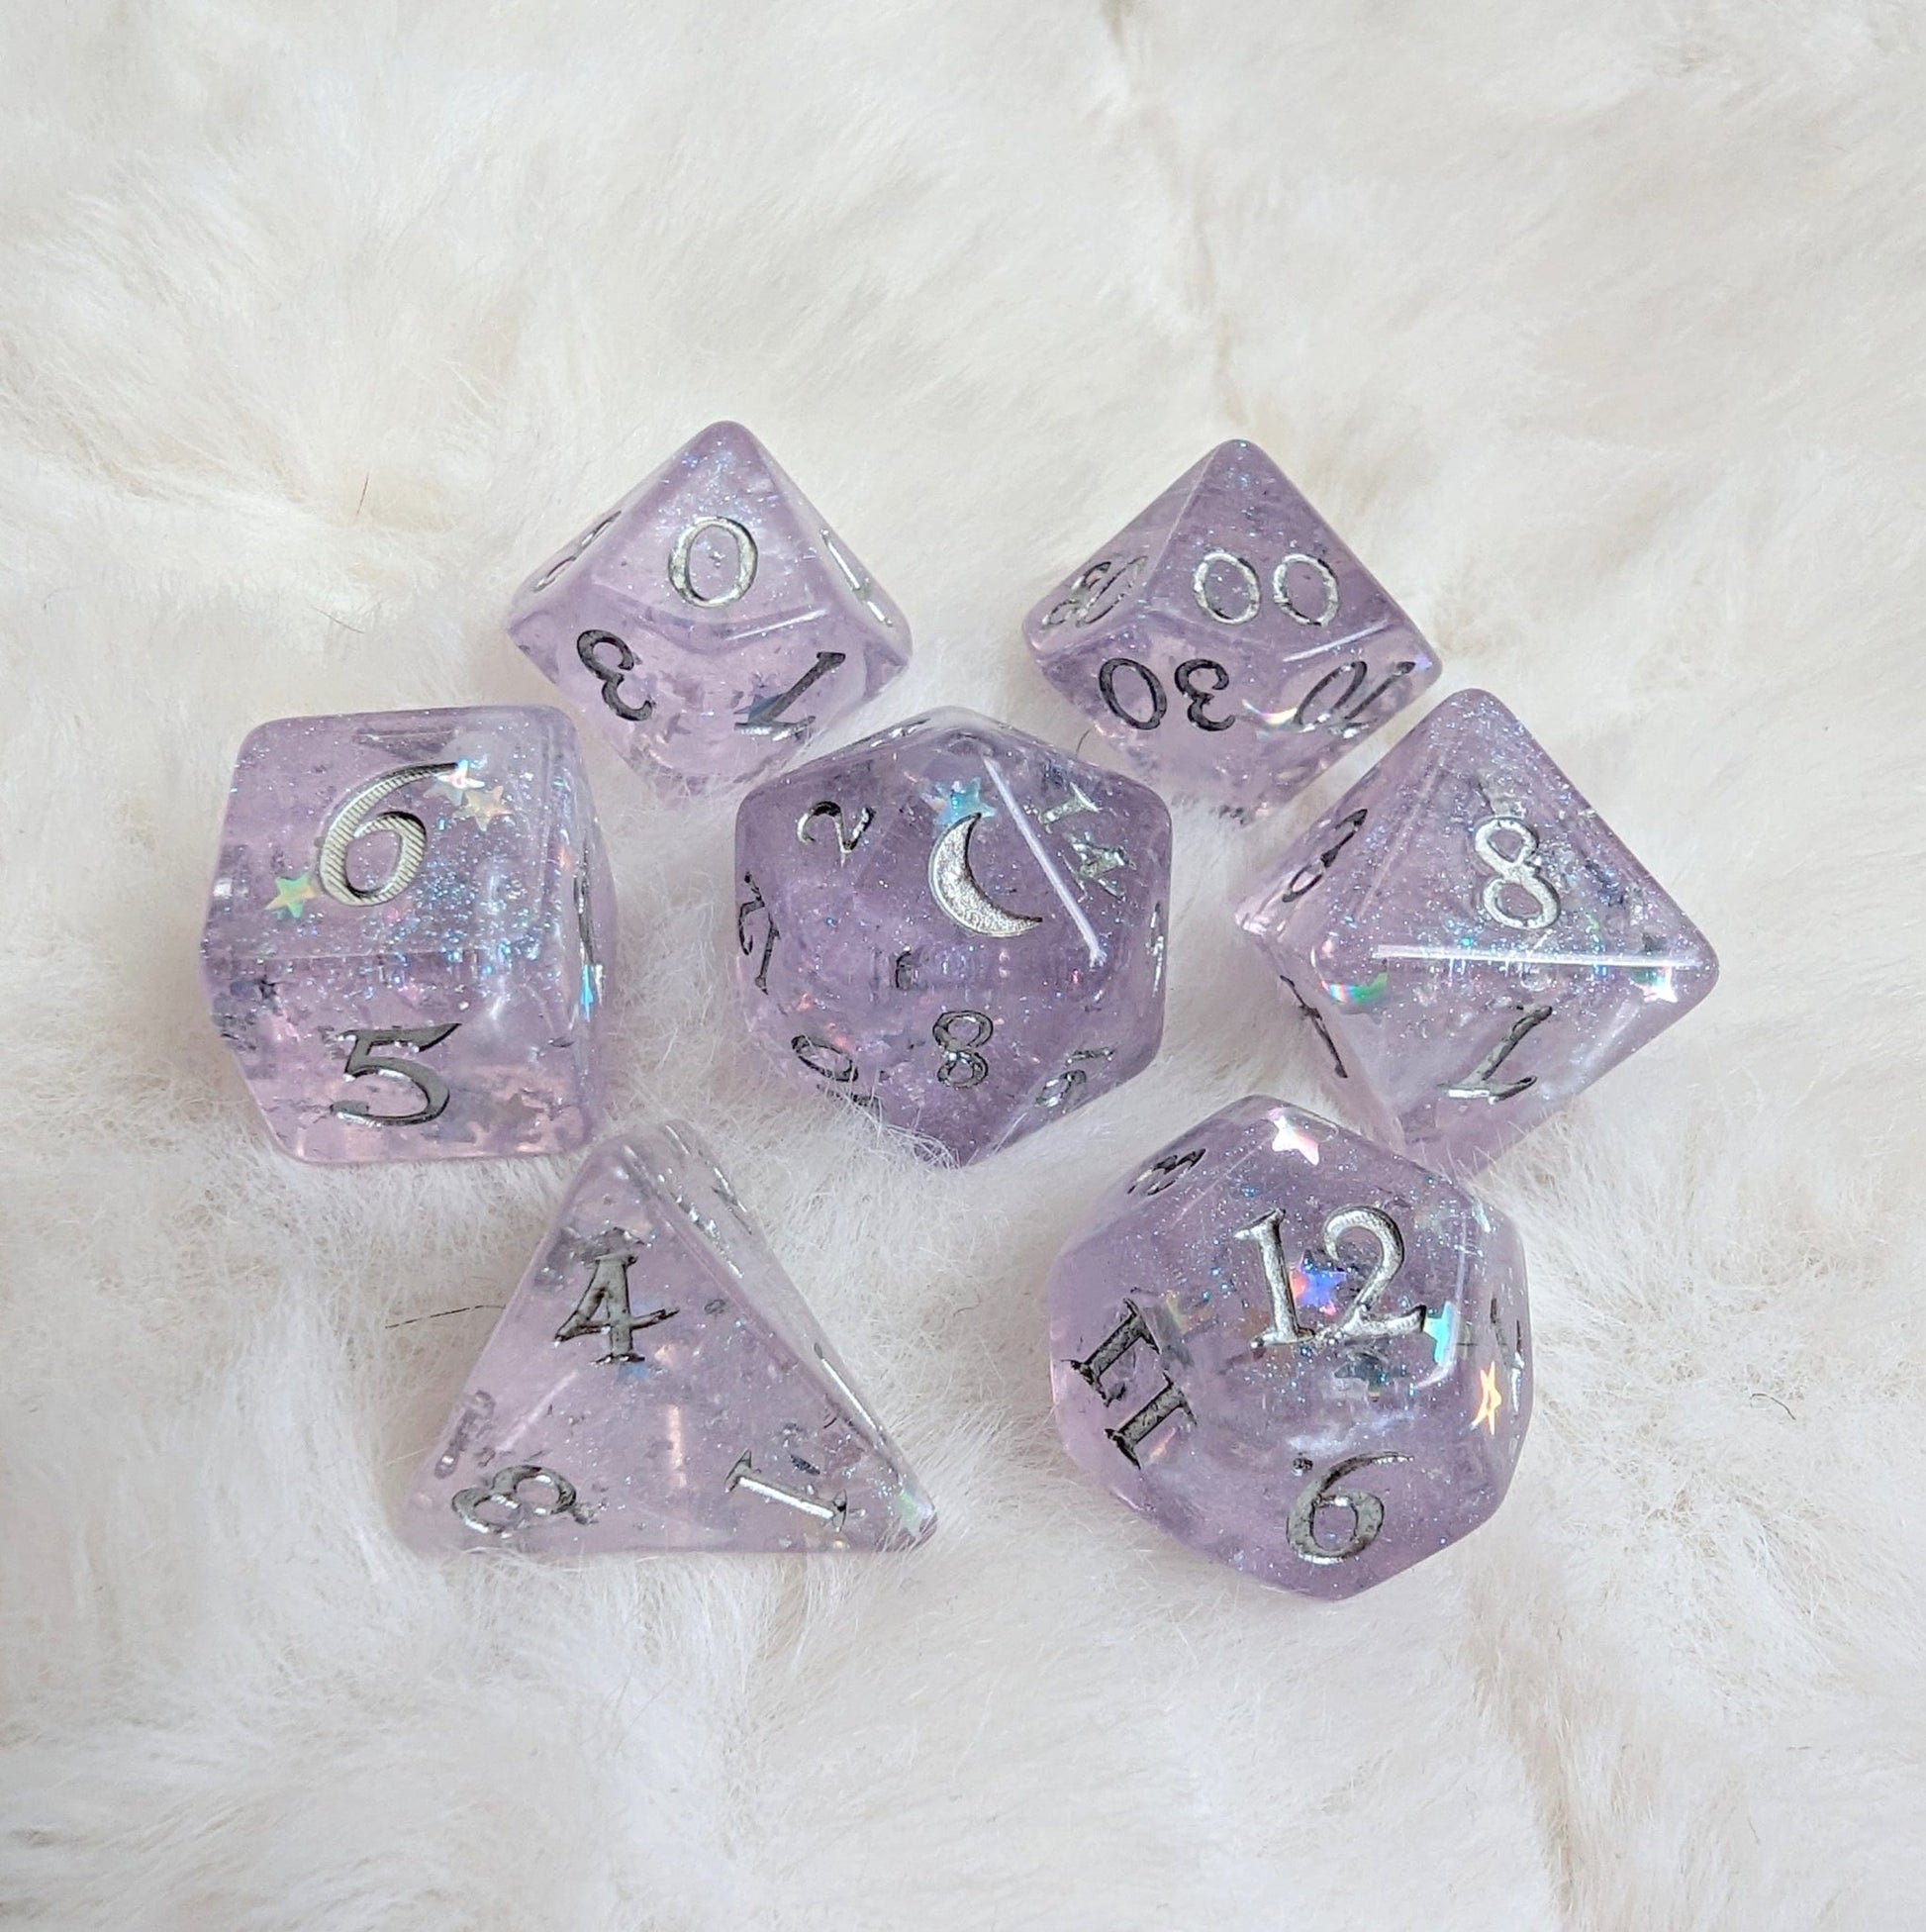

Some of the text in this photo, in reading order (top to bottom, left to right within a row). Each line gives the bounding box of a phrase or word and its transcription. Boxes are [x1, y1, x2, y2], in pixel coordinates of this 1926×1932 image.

[668, 516, 759, 609] 0
[1193, 550, 1339, 628] 00
[576, 628, 654, 723] 3
[1098, 657, 1236, 732] 30
[318, 761, 460, 908] 6
[797, 800, 876, 866] 2
[1474, 816, 1561, 930] 8
[331, 1022, 463, 1127] 5
[933, 1010, 995, 1090] 8
[553, 1251, 681, 1366] 4
[1233, 1205, 1428, 1351] 12
[1065, 1297, 1198, 1471] 11
[724, 1449, 848, 1533] 1
